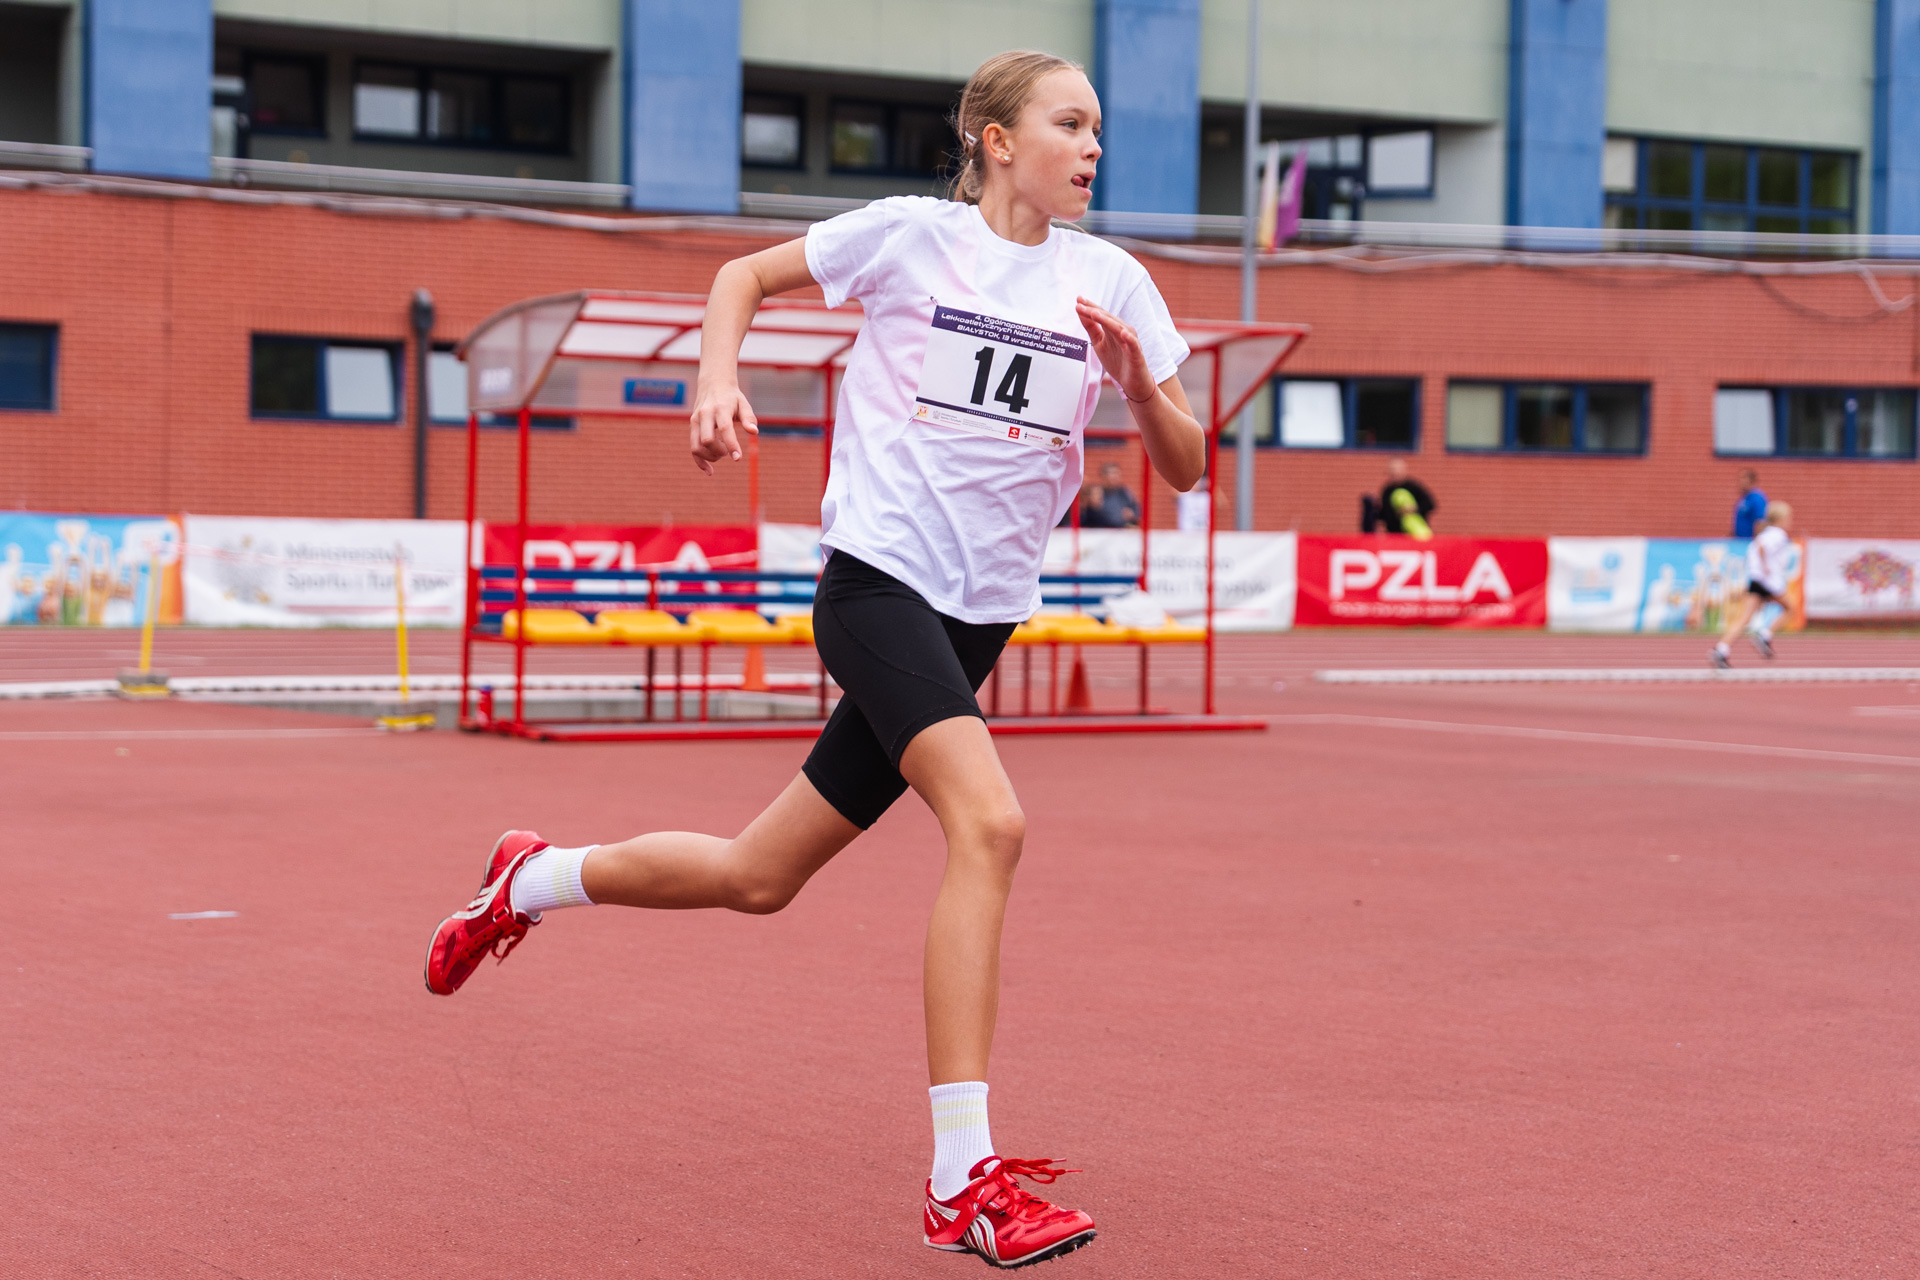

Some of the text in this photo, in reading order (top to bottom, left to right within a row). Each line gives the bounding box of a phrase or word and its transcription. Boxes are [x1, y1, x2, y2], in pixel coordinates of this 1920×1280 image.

[941, 312, 1083, 351] Lekkoatletycznych Nadziei Olimpijskich
[983, 316, 1034, 333] Ogólnopolski
[1011, 337, 1045, 350] września
[970, 346, 1032, 414] 14
[1329, 549, 1513, 601] PZLA
